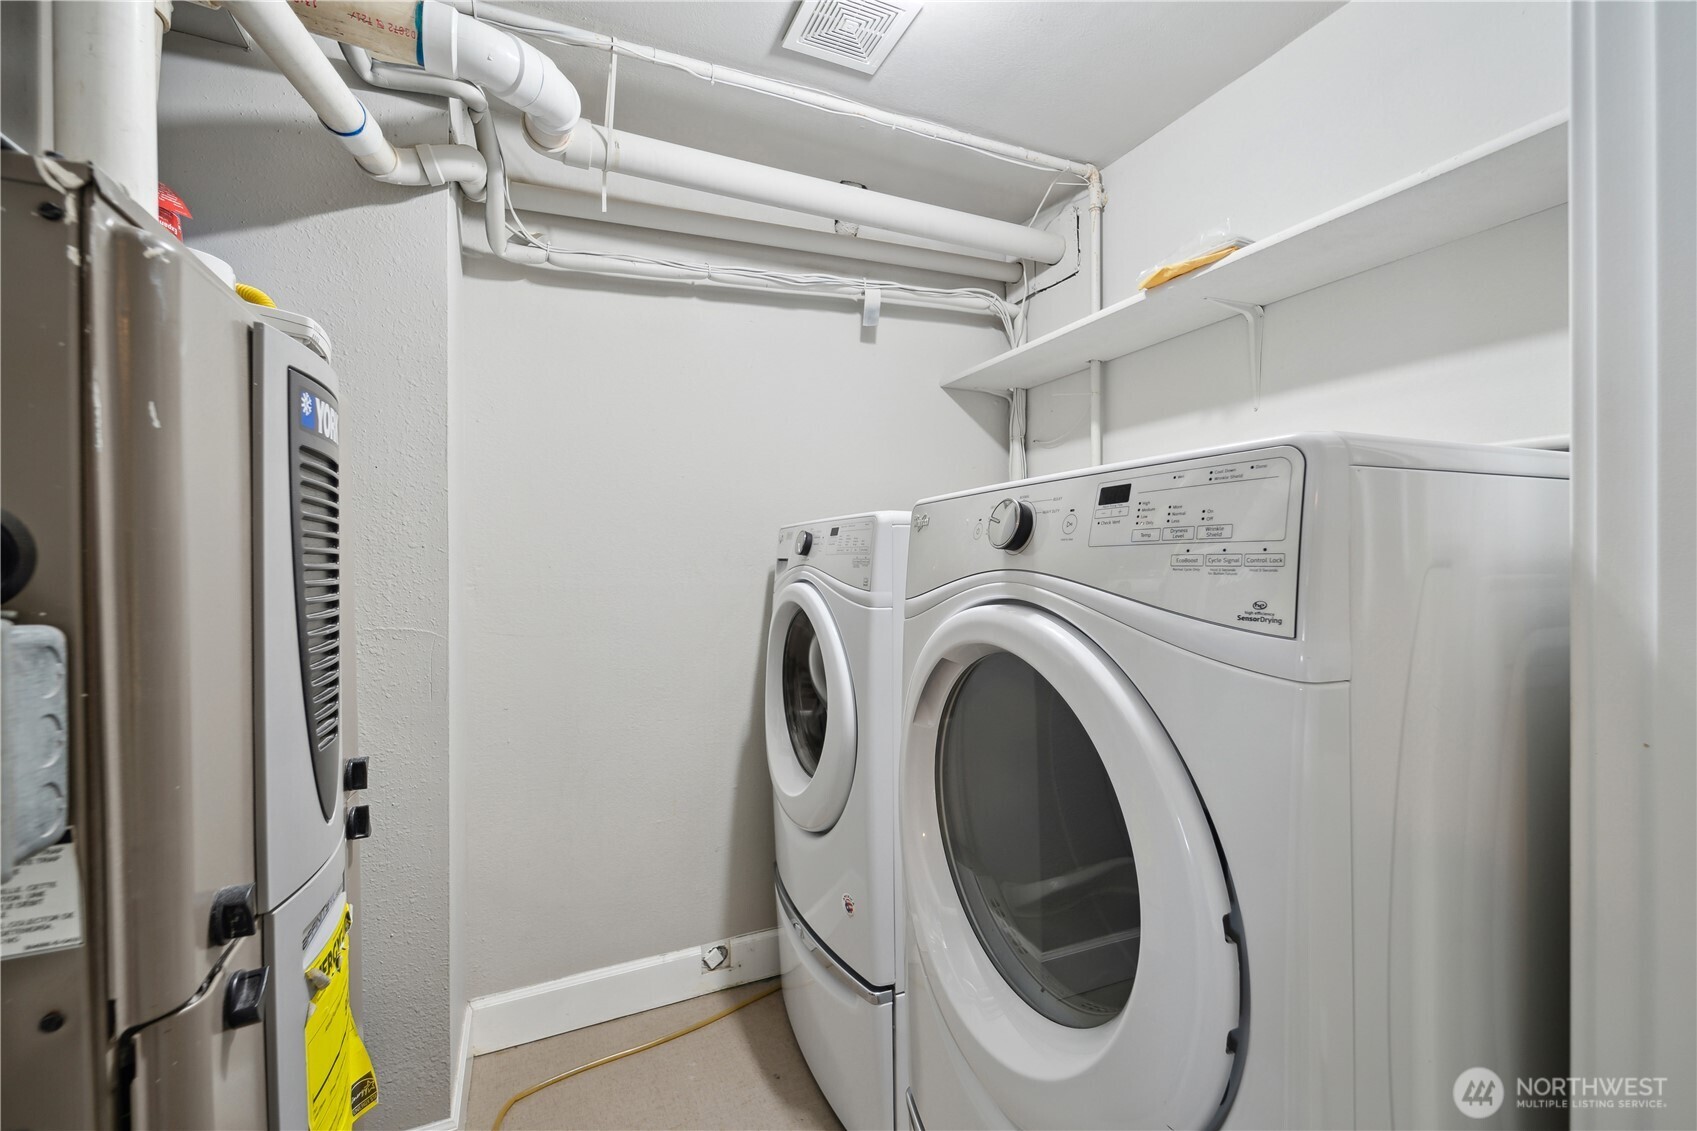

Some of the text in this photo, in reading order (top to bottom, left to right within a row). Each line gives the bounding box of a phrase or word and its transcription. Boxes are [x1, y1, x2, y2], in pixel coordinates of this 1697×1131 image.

[159, 220, 178, 235] Expan
[1223, 557, 1240, 565] Signal
[1236, 615, 1283, 626] SensorDrying
